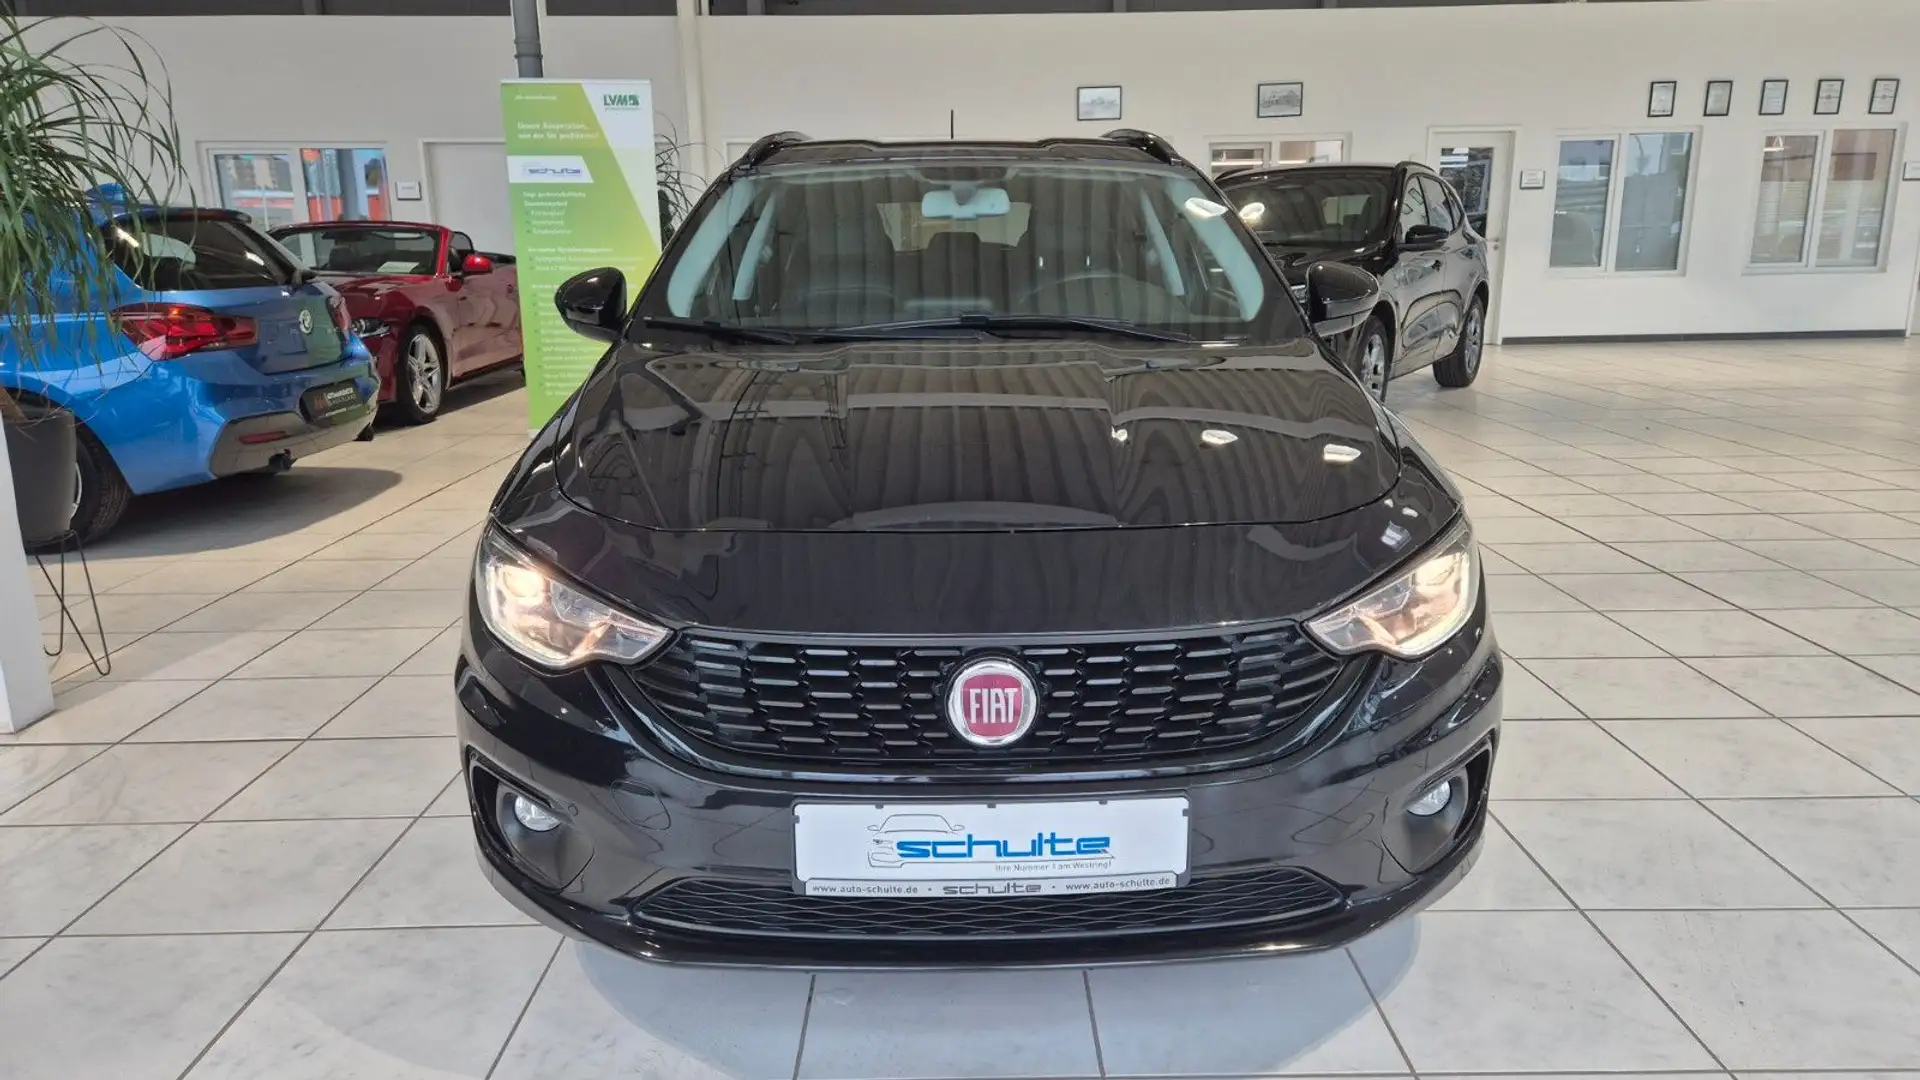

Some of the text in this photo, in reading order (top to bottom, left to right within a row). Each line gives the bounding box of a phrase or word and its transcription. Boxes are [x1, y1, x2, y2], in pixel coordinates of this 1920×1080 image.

[603, 94, 628, 106] LVM
[969, 687, 1018, 724] FIAT
[896, 832, 1110, 858] schulte
[1014, 864, 1049, 872] Nummer
[1072, 860, 1112, 870] Westring!
[812, 876, 1170, 895] www.auto-schulte.de schulte www.auto-schulte.de
